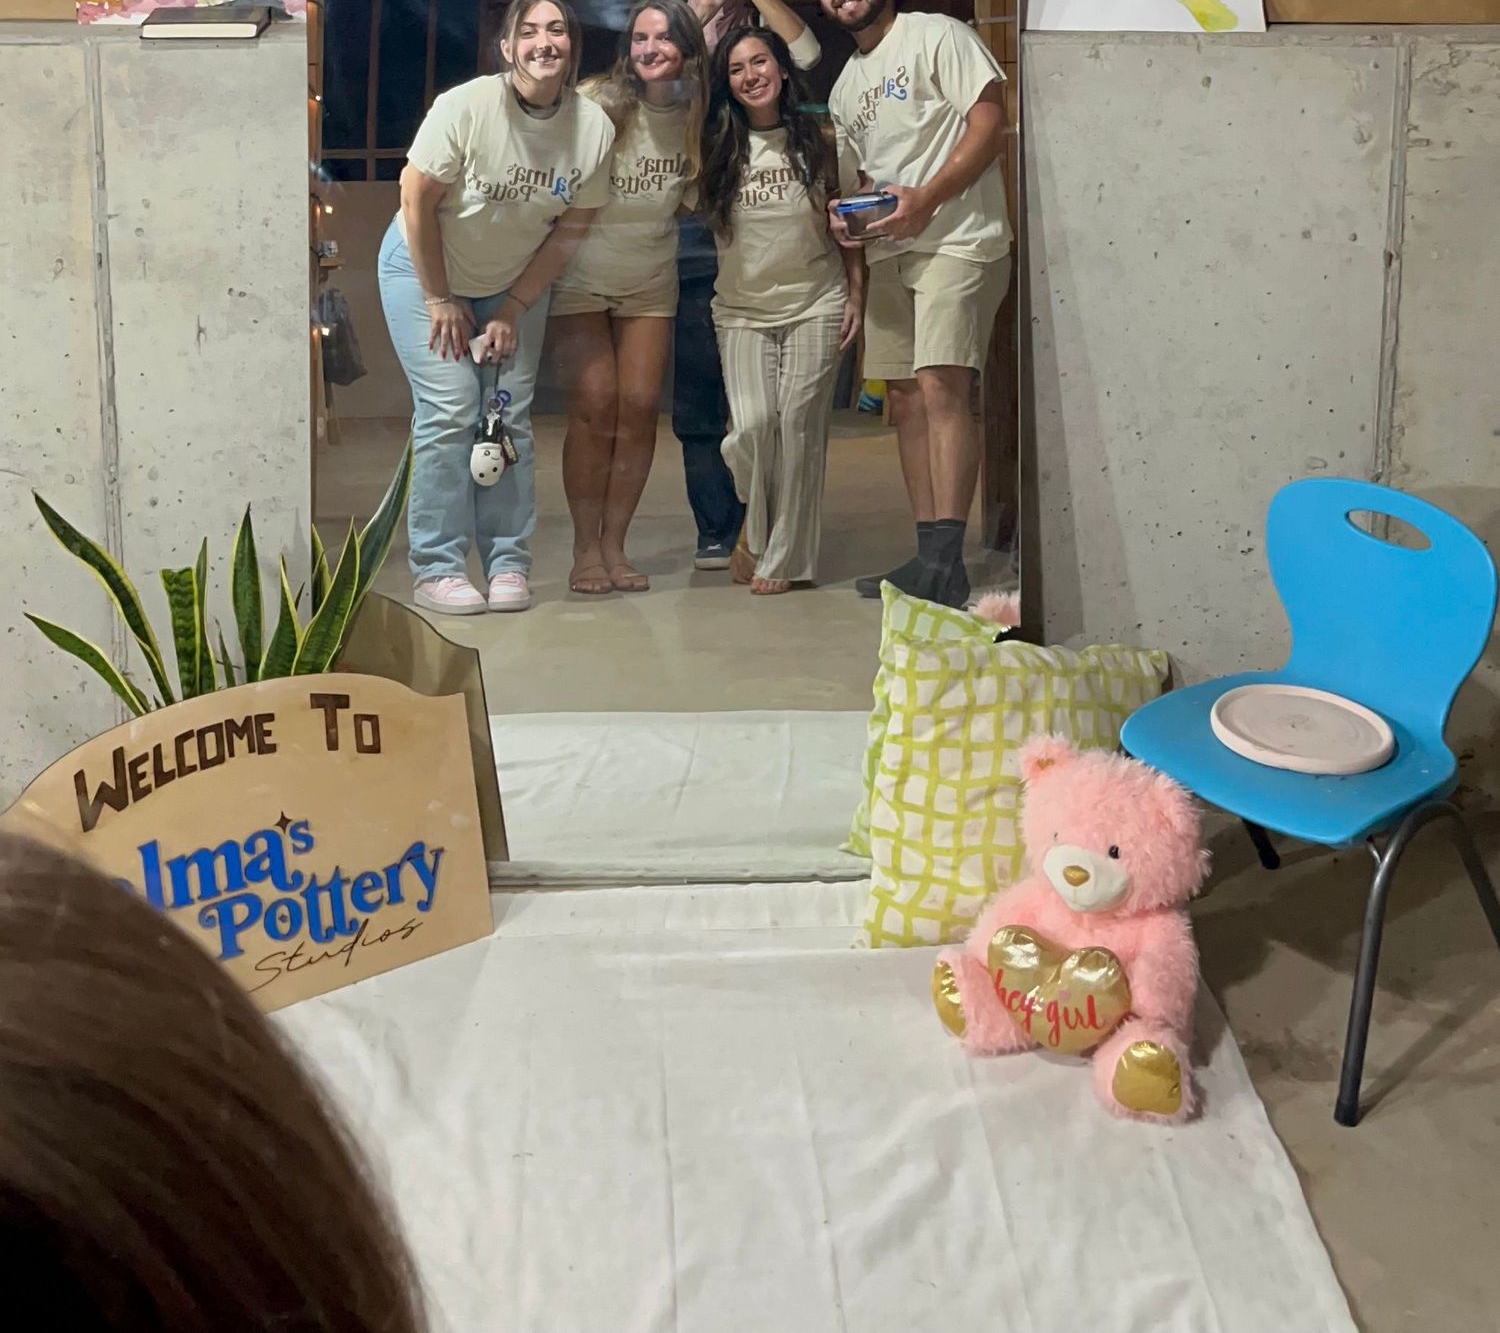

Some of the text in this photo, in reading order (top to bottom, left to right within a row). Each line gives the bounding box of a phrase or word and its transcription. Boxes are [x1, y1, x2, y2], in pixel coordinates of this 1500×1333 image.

[73, 713, 277, 833] WELCOME
[113, 812, 314, 915] lma's
[198, 840, 445, 961] Pottery
[248, 917, 424, 993] Studios
[994, 968, 1104, 1047] hey girl
